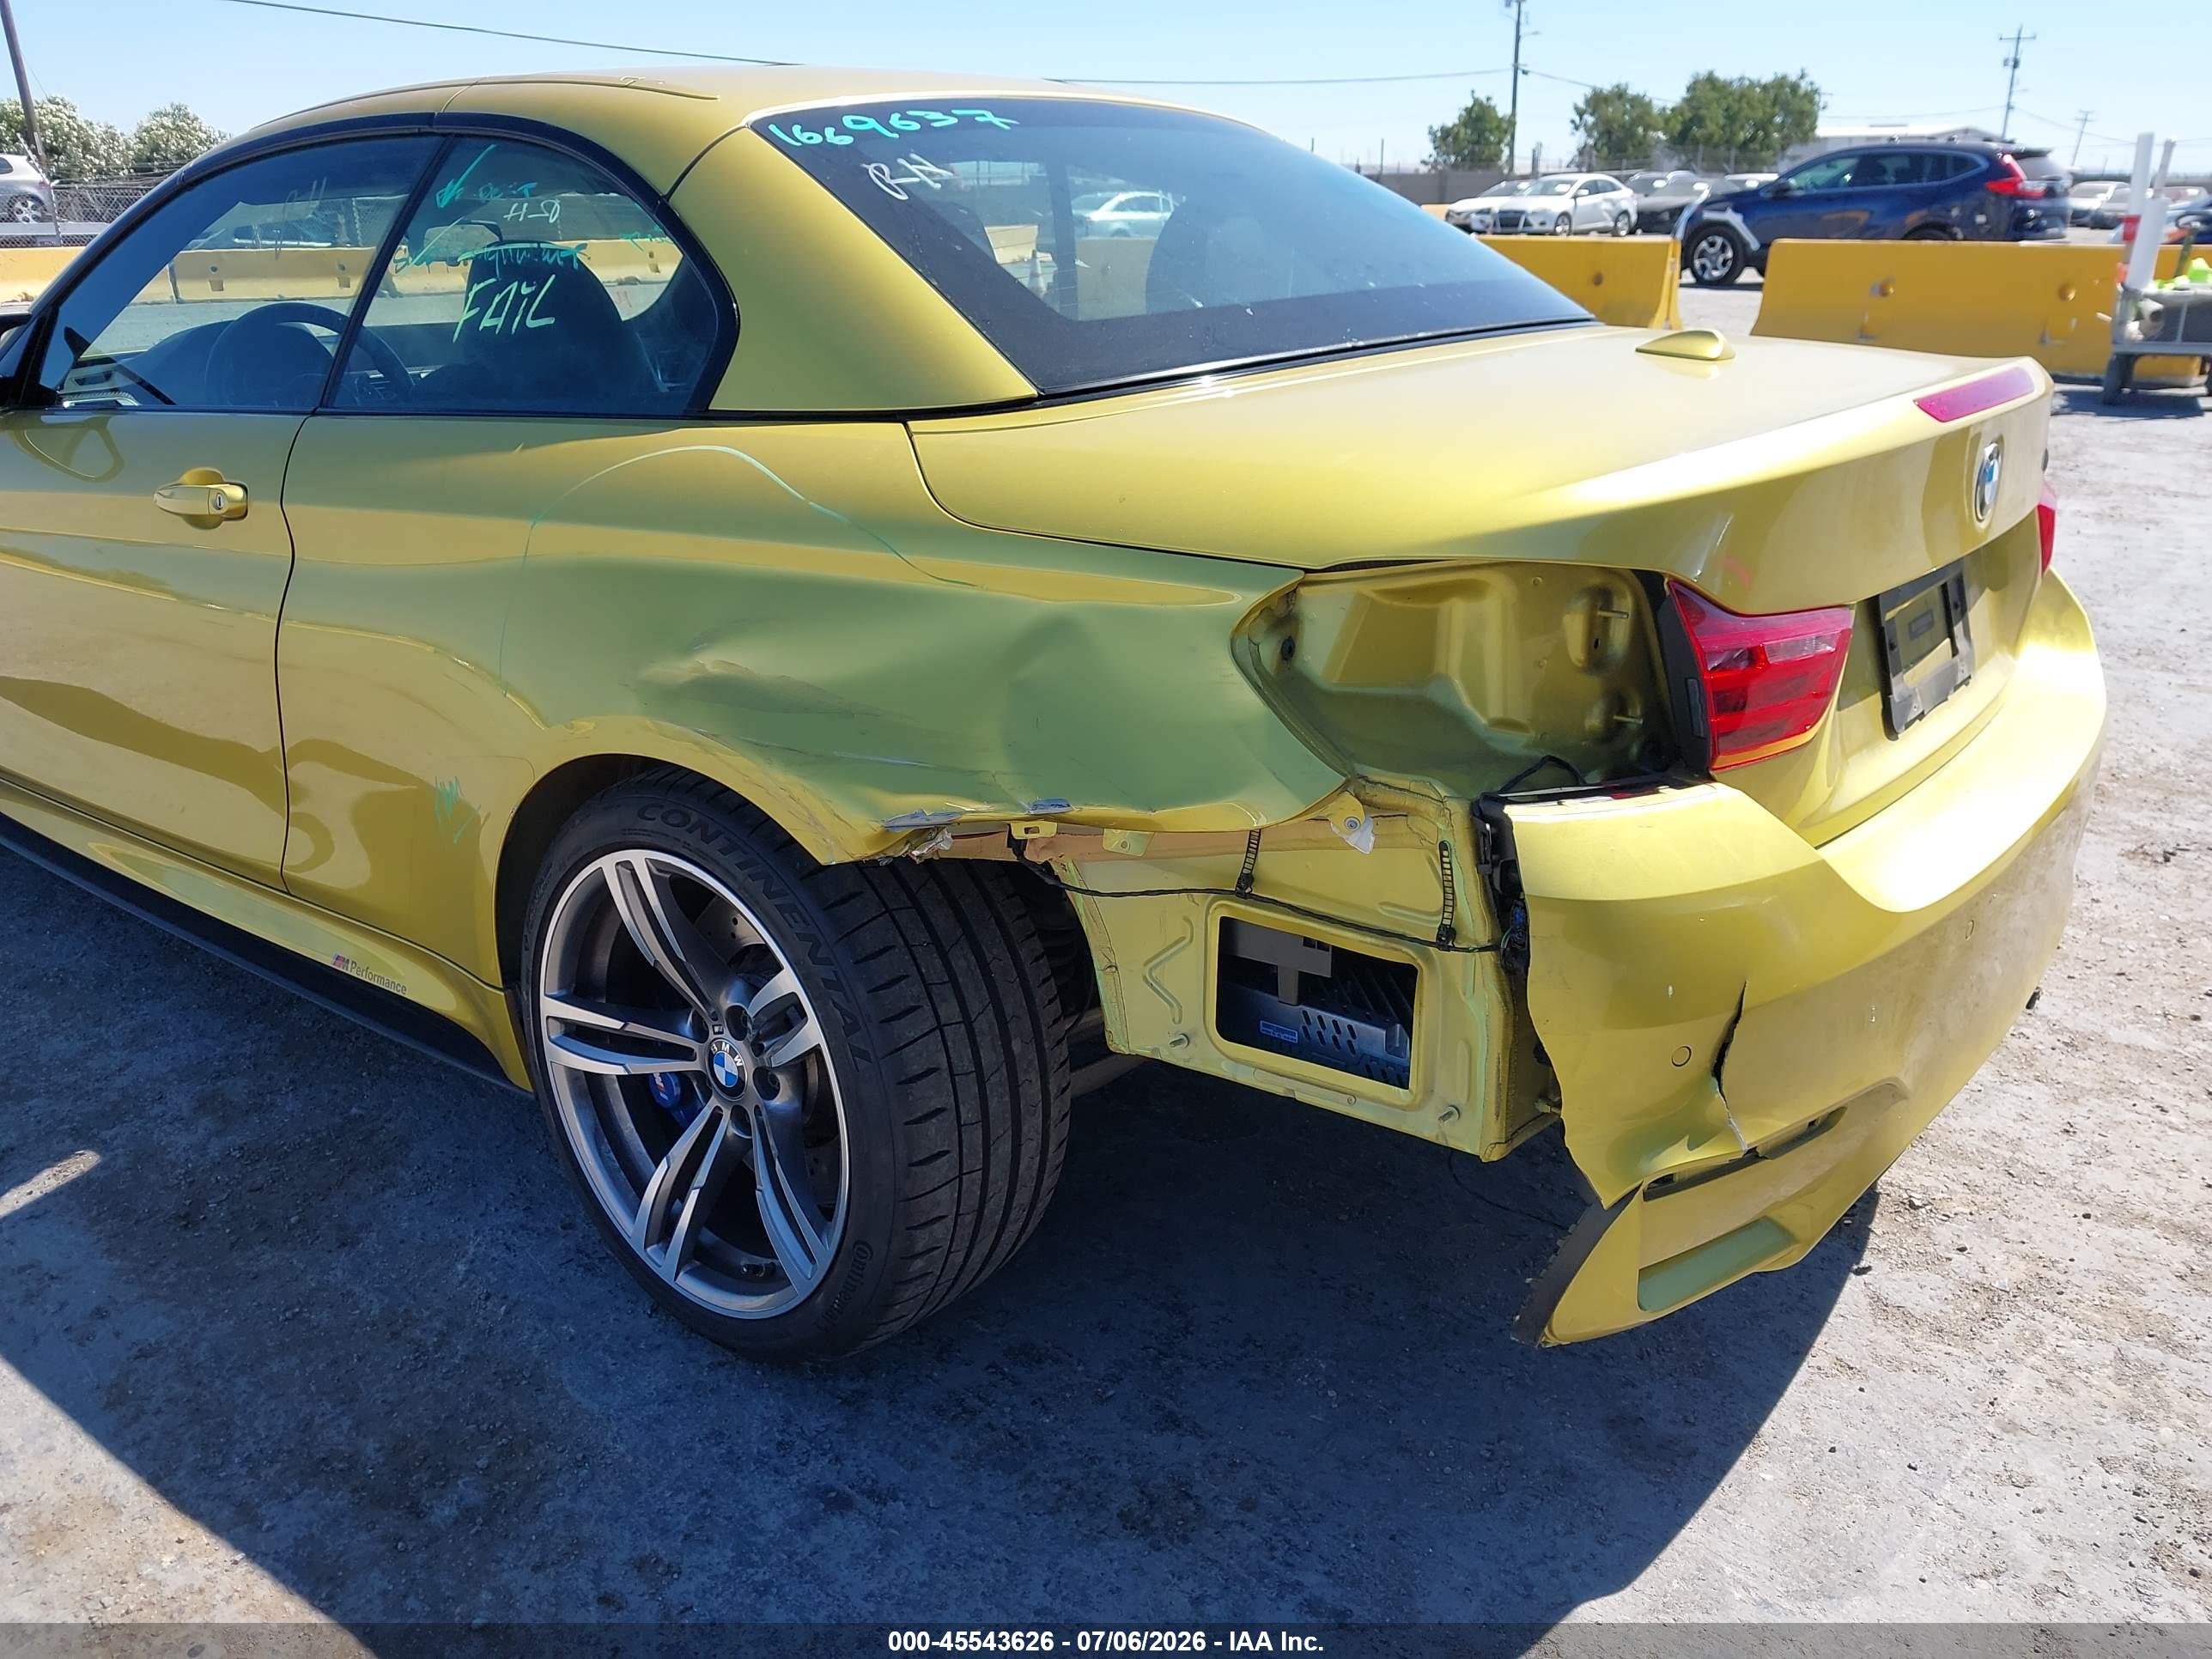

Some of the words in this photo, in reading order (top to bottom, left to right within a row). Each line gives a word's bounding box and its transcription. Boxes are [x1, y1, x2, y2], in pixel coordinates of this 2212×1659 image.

[636, 803, 873, 1072] CONTINENTAL
[349, 961, 407, 995] Performance
[711, 1042, 743, 1066] BMW
